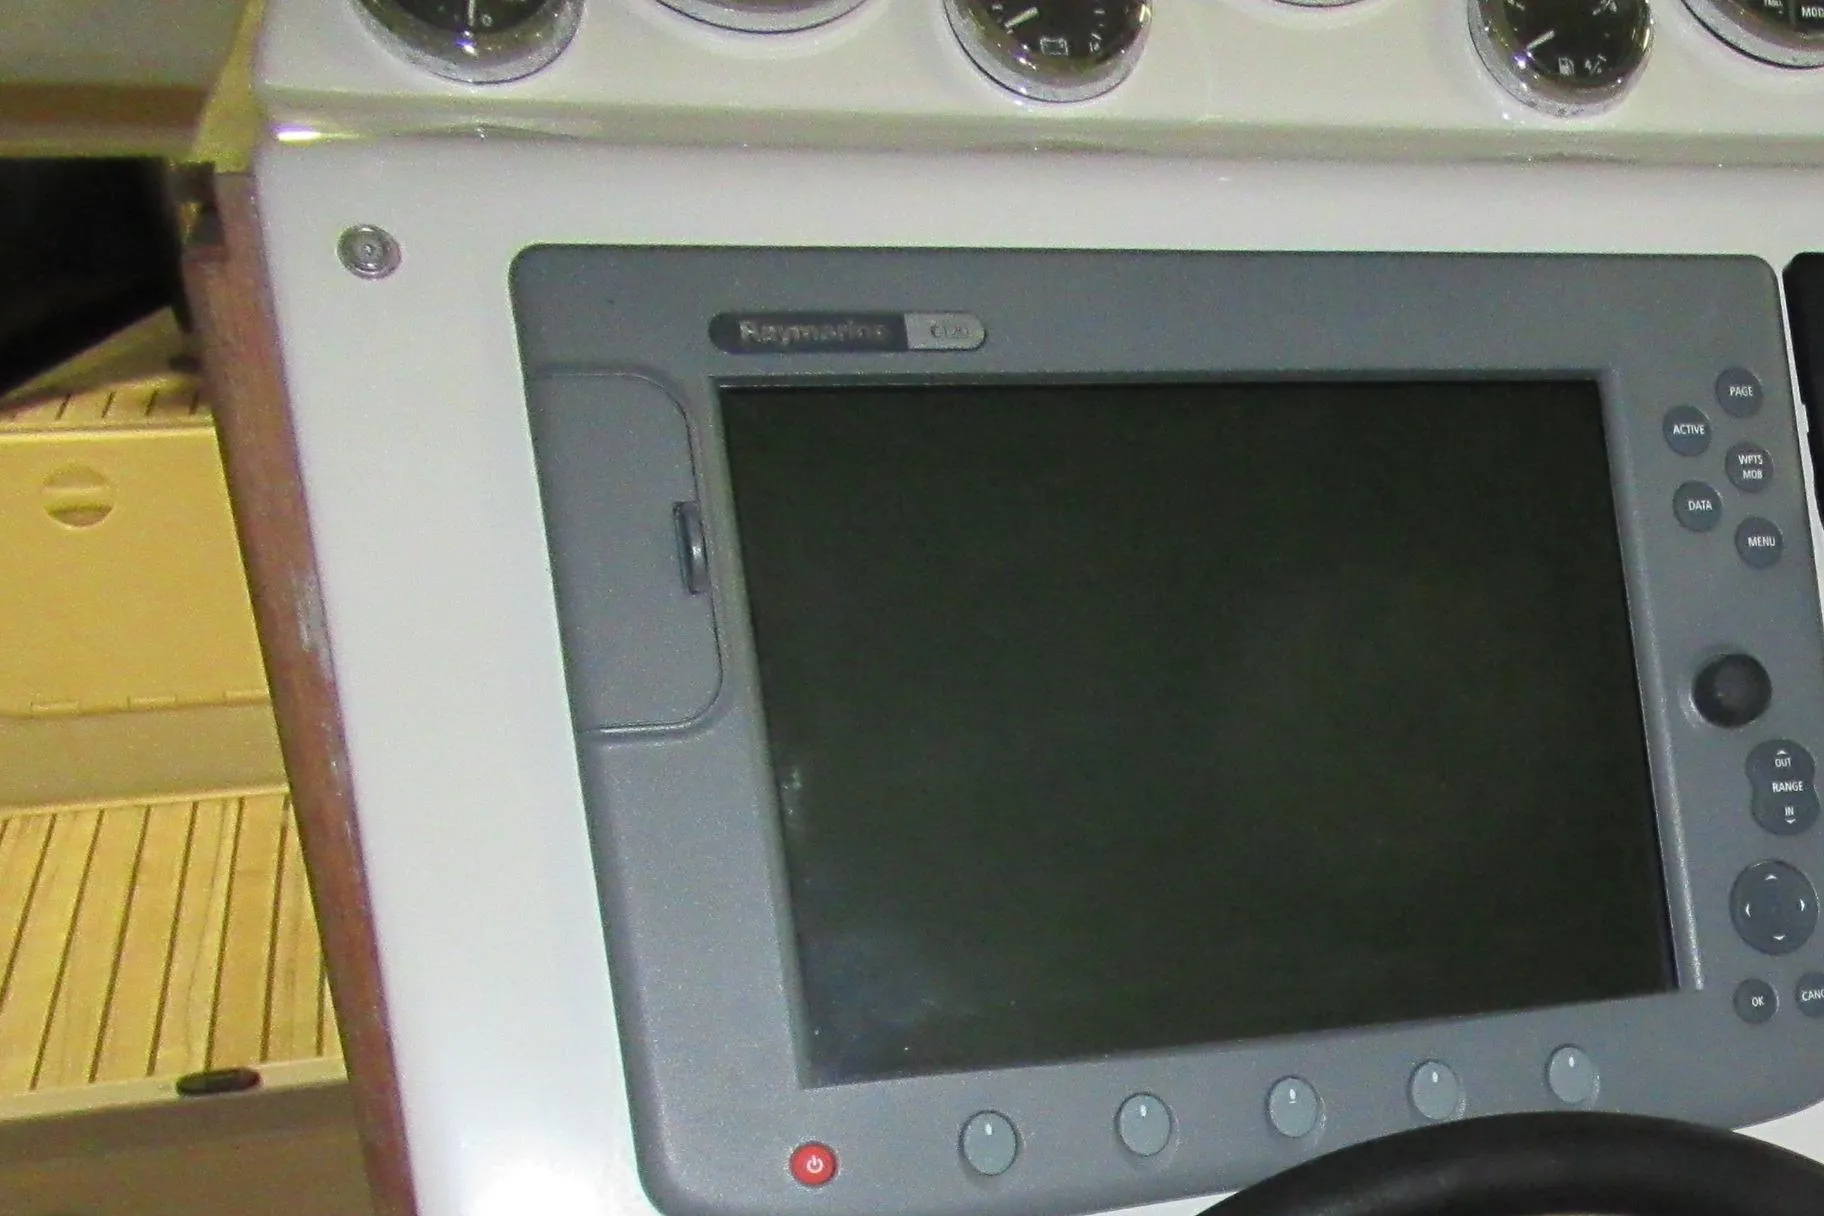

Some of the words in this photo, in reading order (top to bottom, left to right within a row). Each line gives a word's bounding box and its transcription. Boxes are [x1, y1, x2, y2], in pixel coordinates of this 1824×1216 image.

[1729, 386, 1753, 397] PAGE
[1672, 424, 1705, 435] ACTIVE
[1738, 454, 1763, 465] WPTS
[1742, 470, 1763, 480] MOB
[1688, 500, 1713, 511] DATA
[1748, 536, 1776, 547] MENU
[1774, 757, 1791, 768] OUT
[1772, 781, 1804, 792] RANGE
[1784, 806, 1794, 816] IN
[1751, 996, 1764, 1007] OK
